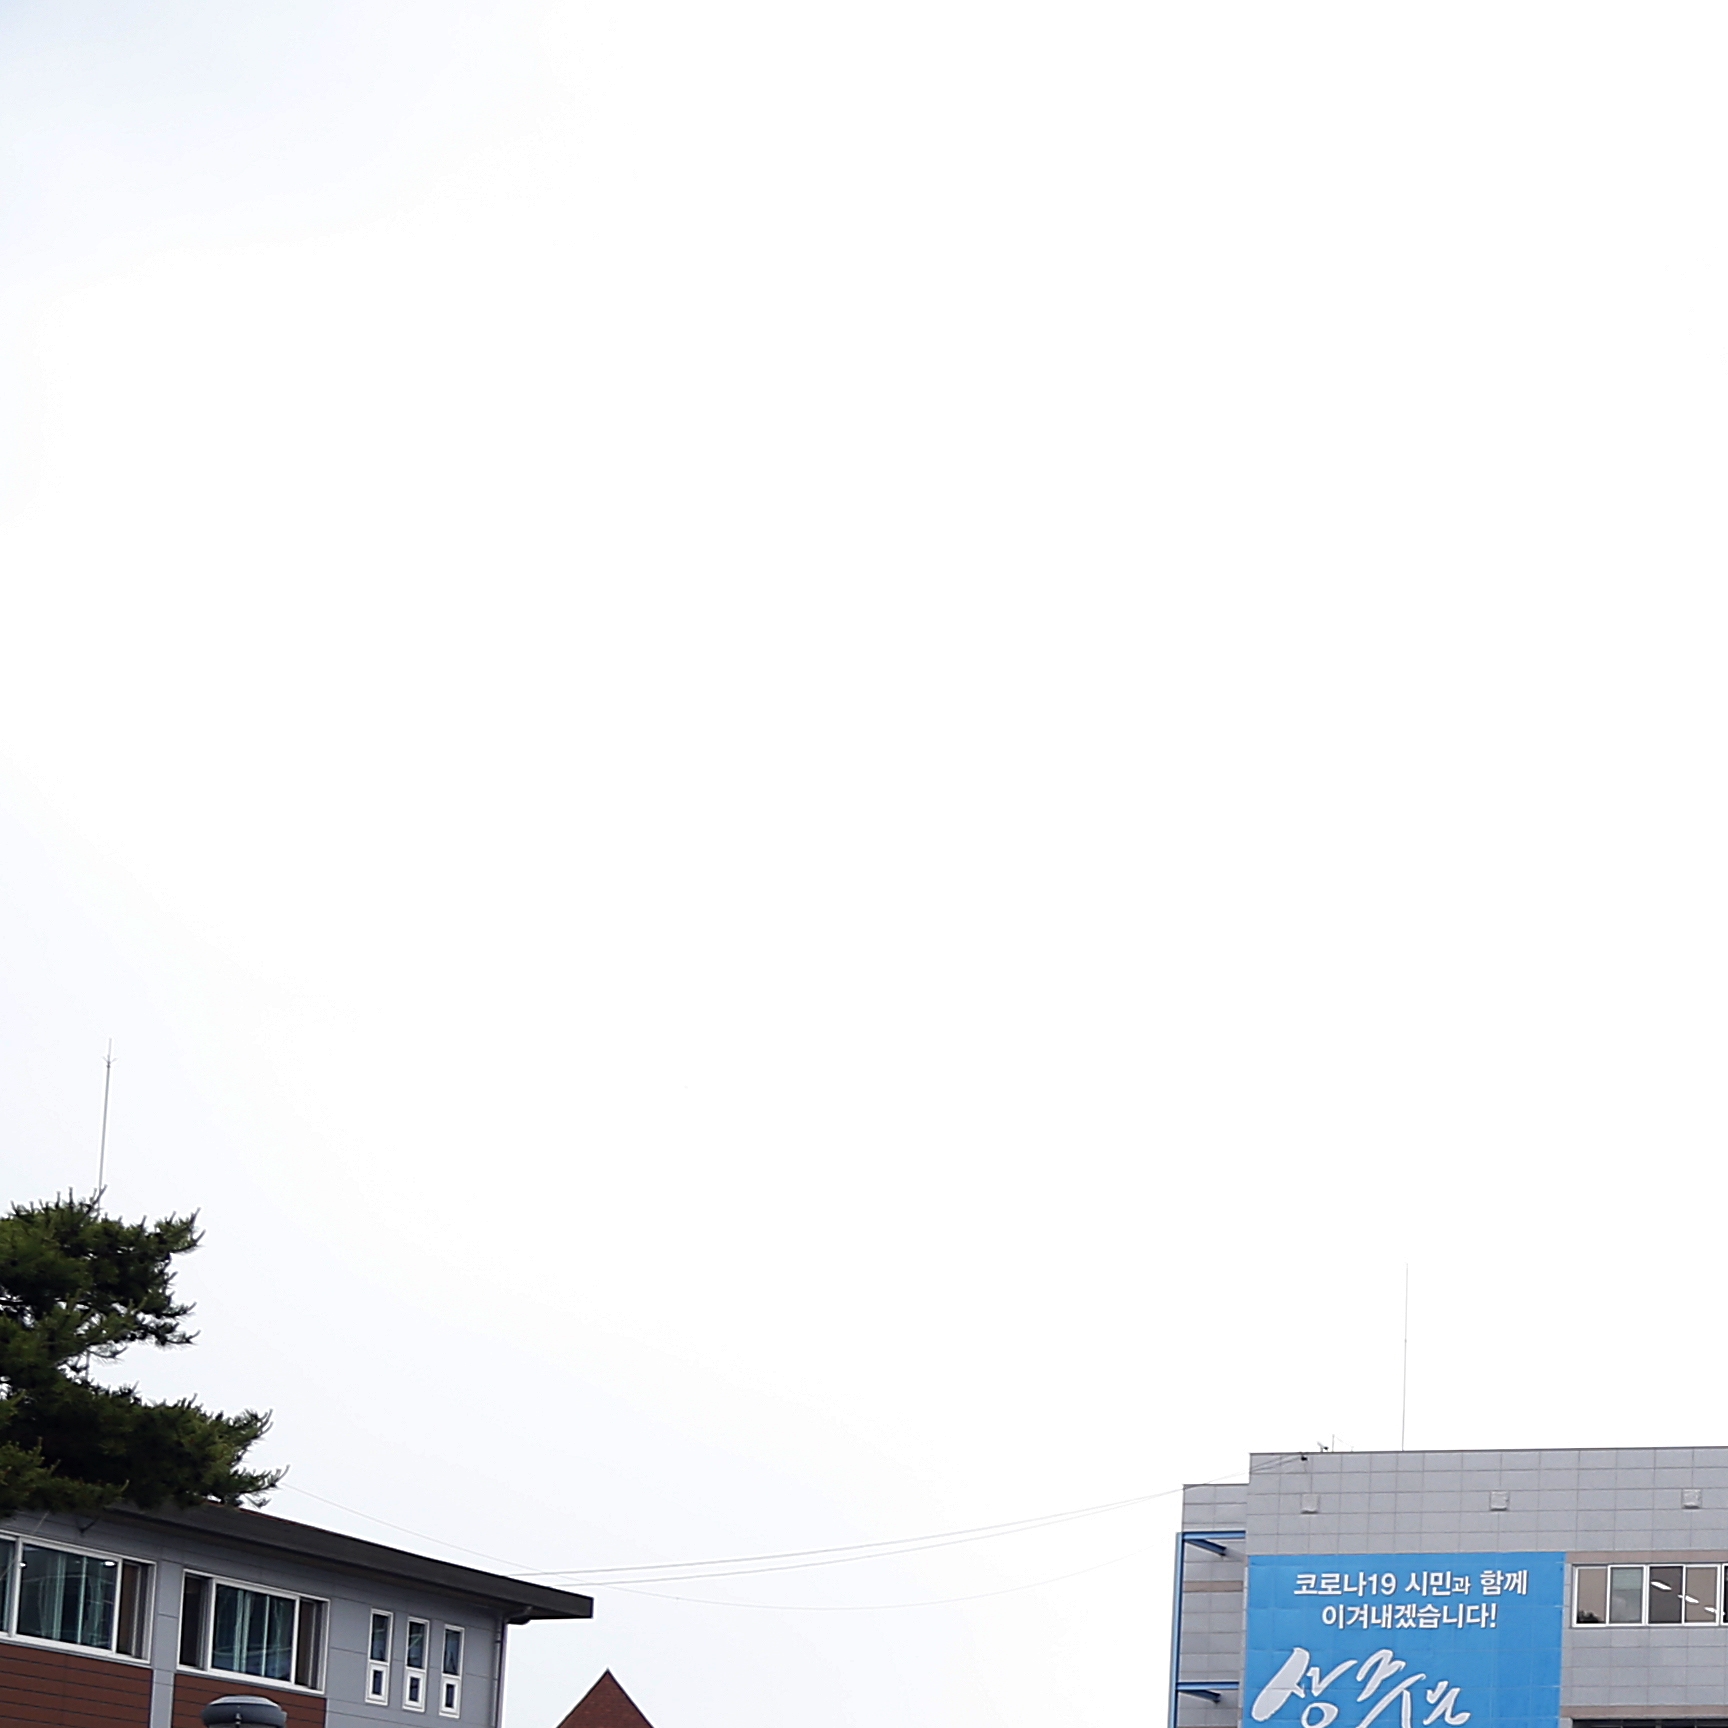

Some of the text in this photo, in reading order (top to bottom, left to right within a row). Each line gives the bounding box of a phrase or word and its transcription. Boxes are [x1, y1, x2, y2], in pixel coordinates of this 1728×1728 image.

[1293, 1570, 1528, 1597] 코로나19 시민과 함께
[1321, 1602, 1499, 1630] 이겨내겠습니다!
